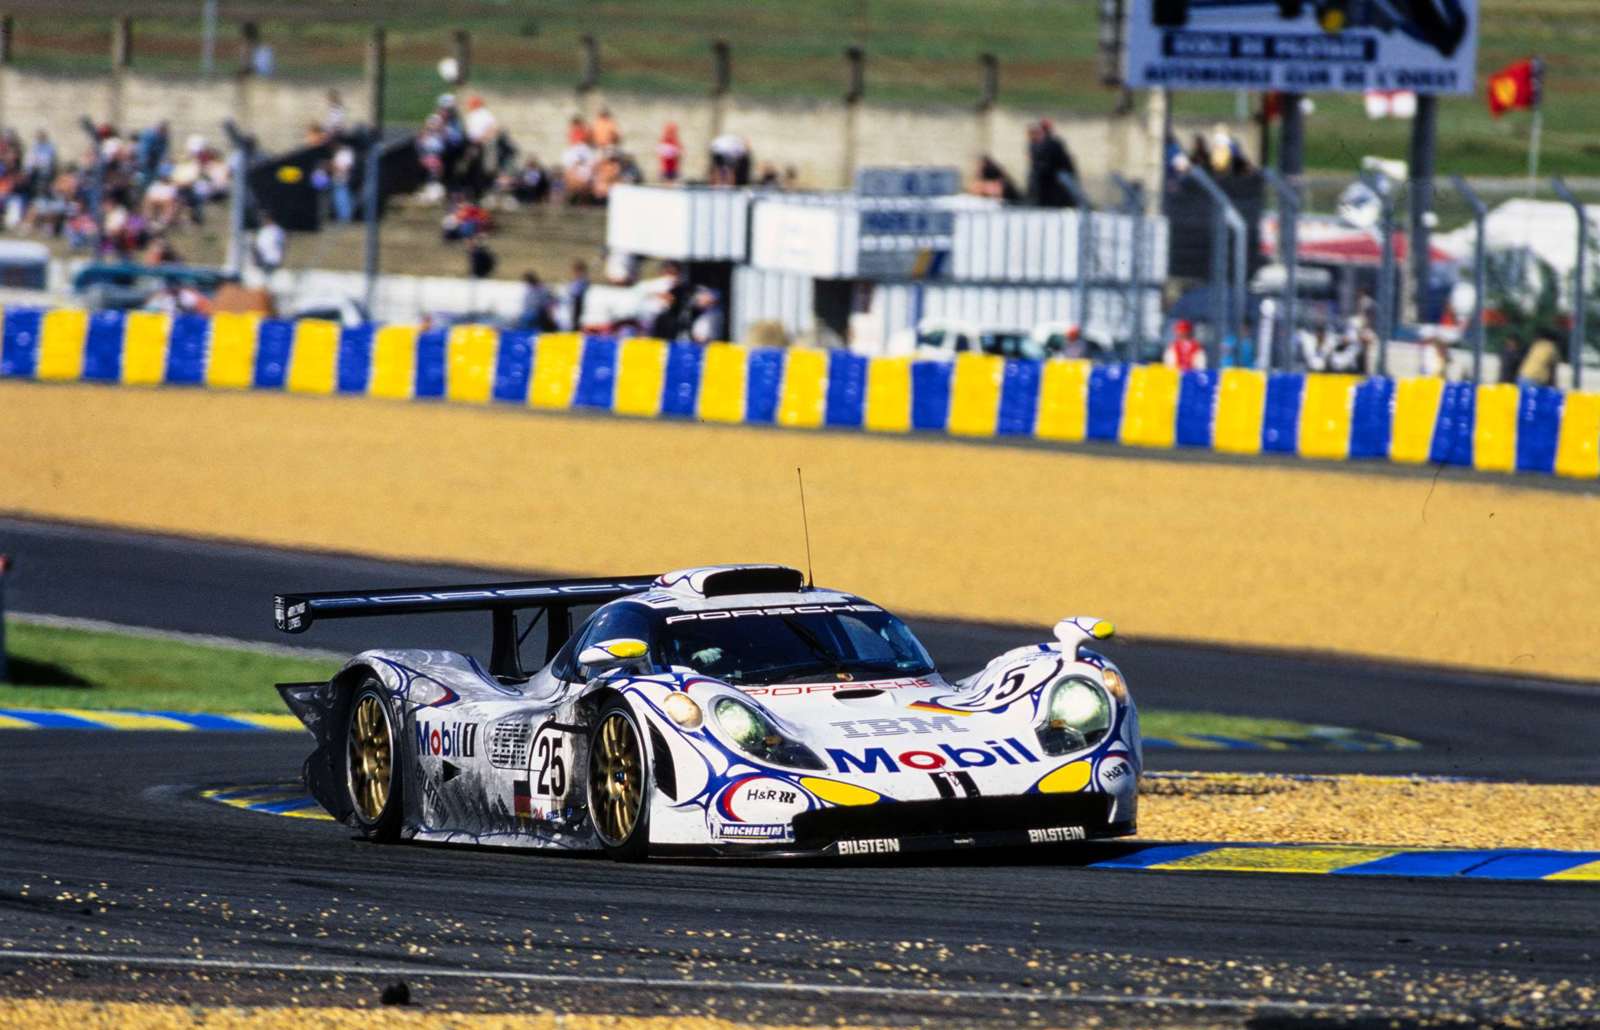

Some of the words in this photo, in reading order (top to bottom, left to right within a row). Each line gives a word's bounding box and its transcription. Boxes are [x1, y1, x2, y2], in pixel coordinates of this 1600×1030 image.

[666, 604, 883, 624] PORSCHE
[830, 715, 970, 738] IBM
[416, 721, 461, 757] Mobil
[825, 737, 1040, 774] Mobil
[537, 735, 566, 797] 25
[747, 789, 776, 801] H&R
[723, 825, 782, 836] MICHELIN
[1028, 826, 1086, 843] BILSTEIN
[837, 838, 900, 855] BILSTEIN
